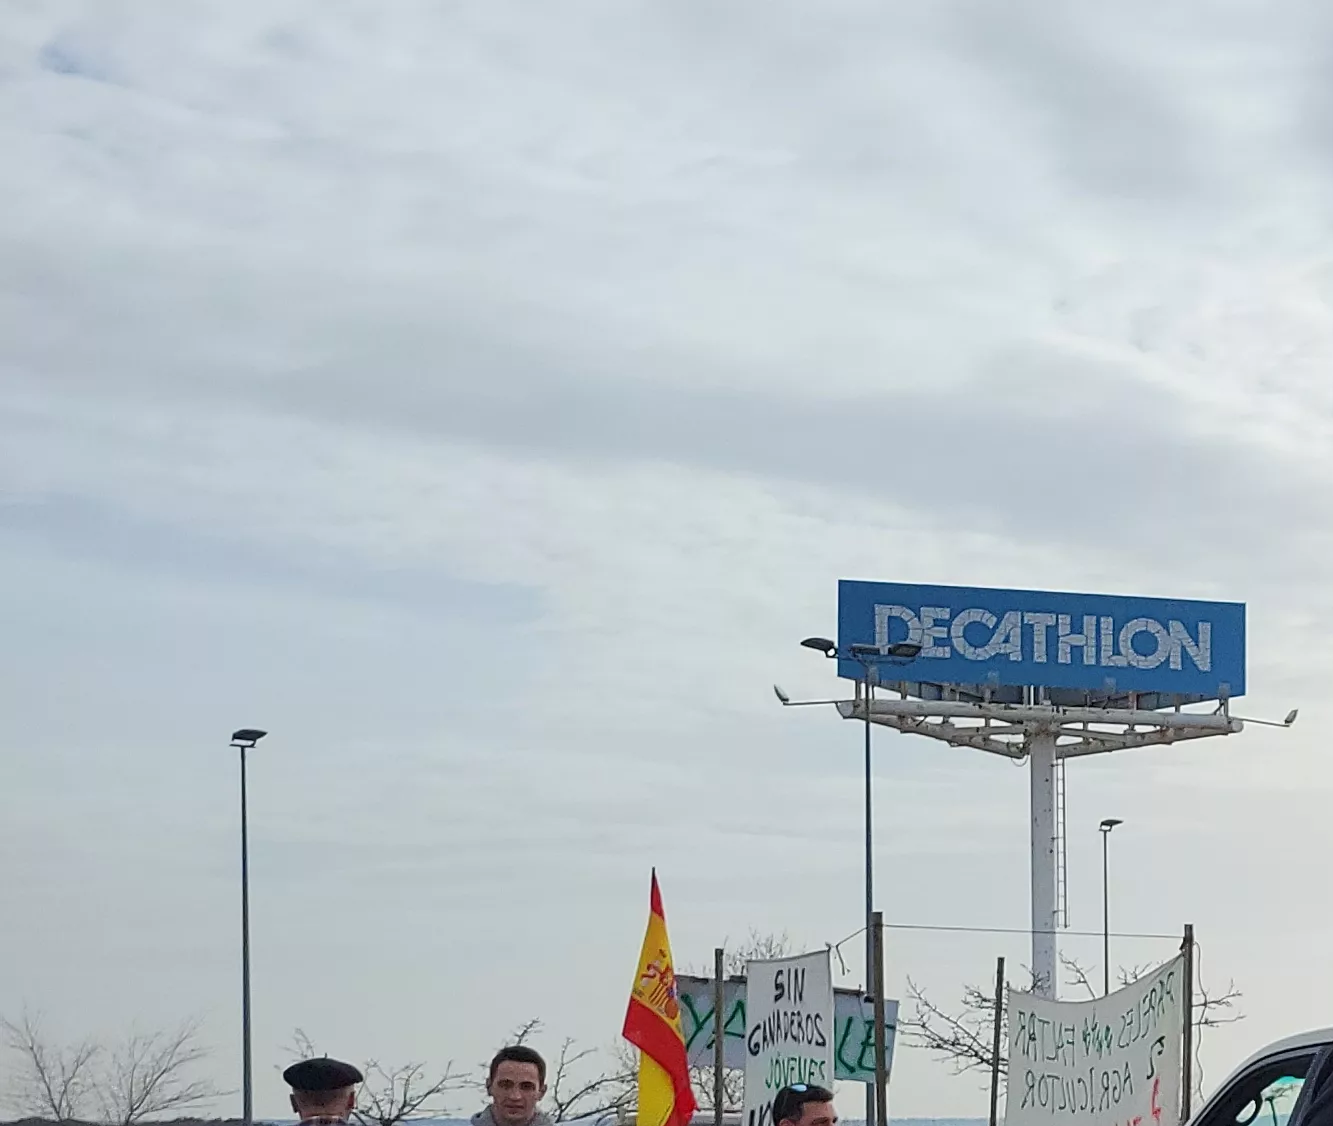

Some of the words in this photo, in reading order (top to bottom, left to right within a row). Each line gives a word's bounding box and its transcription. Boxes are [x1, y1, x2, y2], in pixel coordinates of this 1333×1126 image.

[874, 604, 1211, 672] DECATHLON
[774, 967, 806, 1005] SIN
[747, 1009, 827, 1056] GANADEROS
